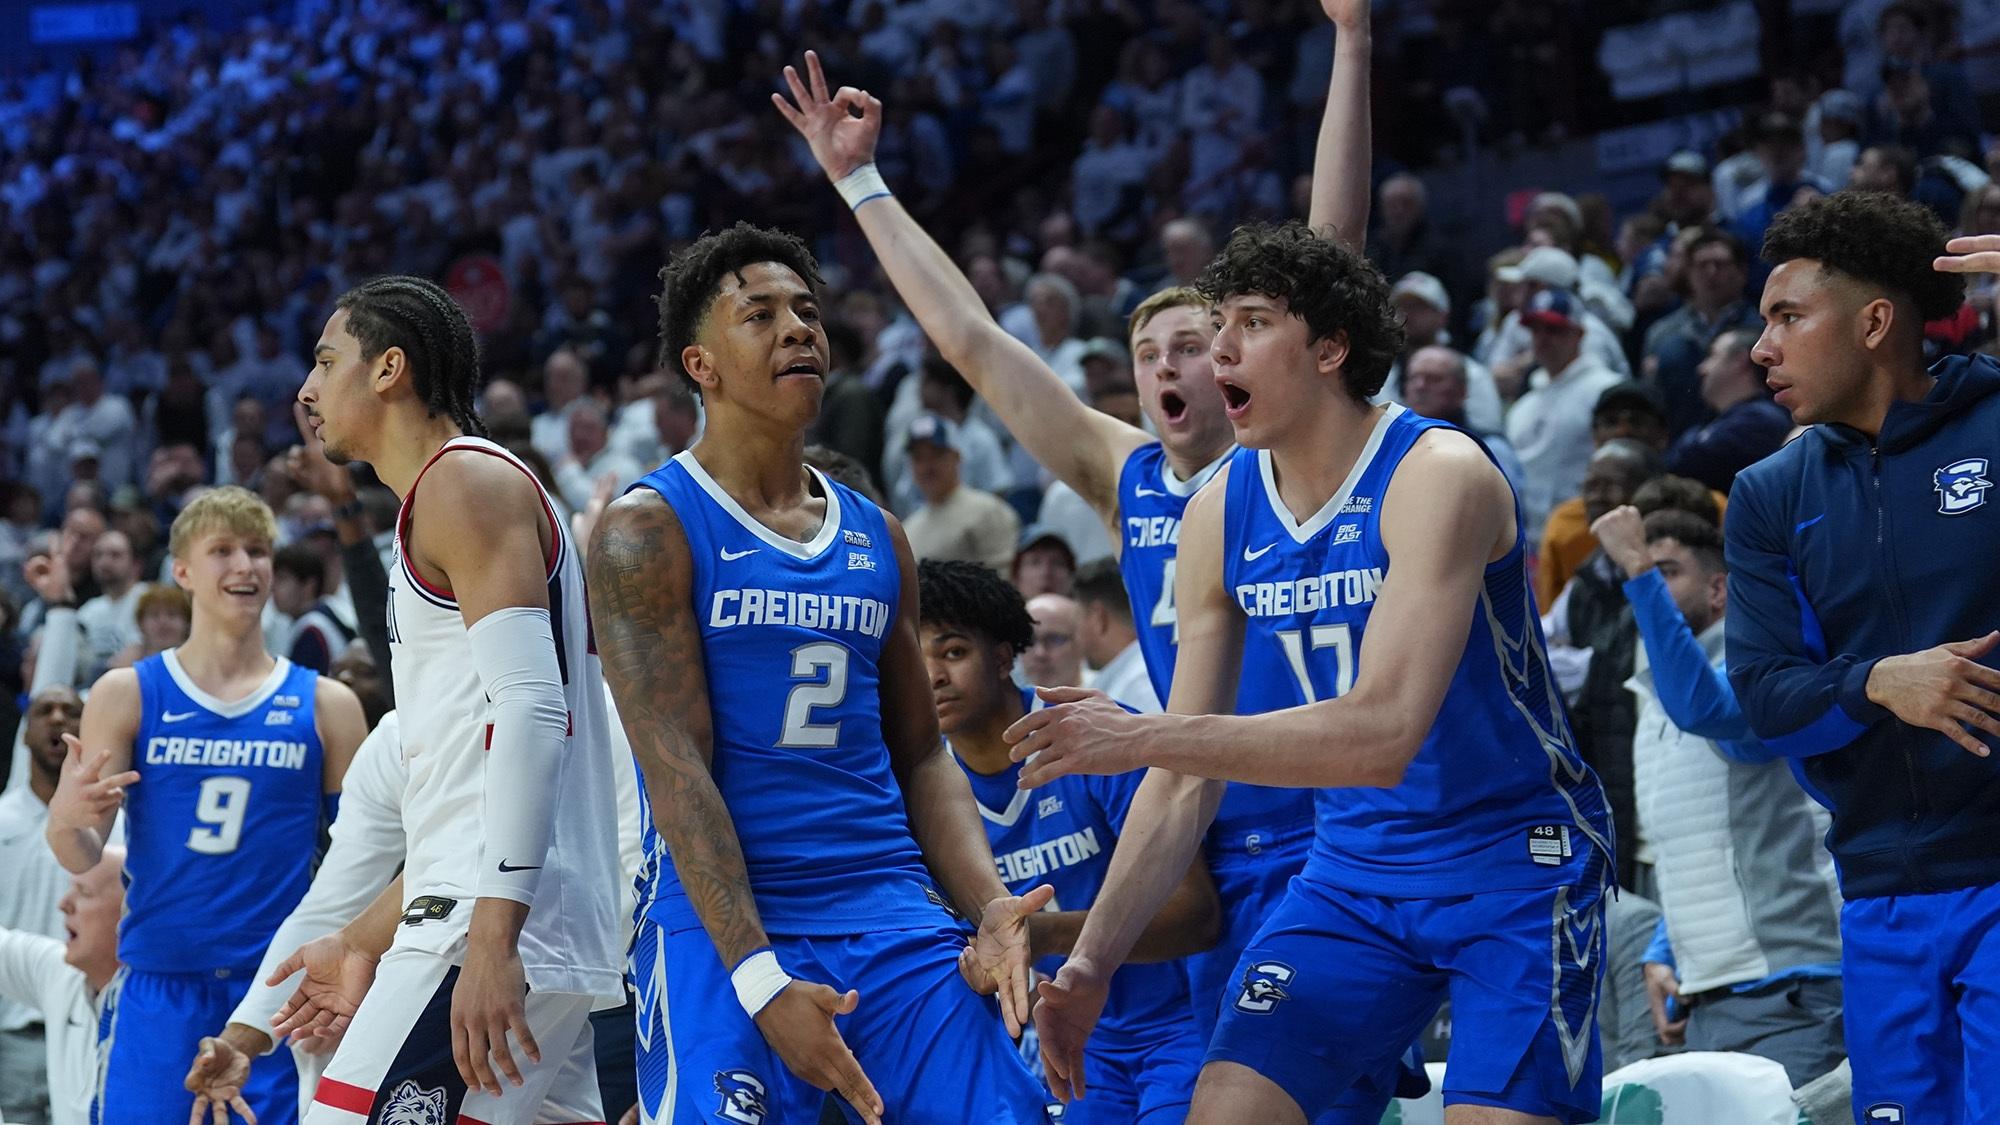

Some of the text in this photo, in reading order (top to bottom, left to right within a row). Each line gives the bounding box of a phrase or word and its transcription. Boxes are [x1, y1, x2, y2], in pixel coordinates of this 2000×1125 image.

[1356, 496, 1373, 504] THE
[1341, 504, 1372, 513] CHANGE
[1338, 524, 1357, 533] BIG
[844, 534, 872, 548] CHANGE
[1334, 530, 1362, 542] EAST
[849, 552, 868, 561] BIG
[848, 560, 876, 568] EAST
[709, 588, 889, 640] CREIGHTON
[1275, 622, 1354, 705] 17
[773, 641, 850, 748] 2
[146, 736, 308, 770] CREIGHTON
[186, 775, 252, 856] 9
[1534, 826, 1554, 836] 48
[430, 904, 443, 913] 46
